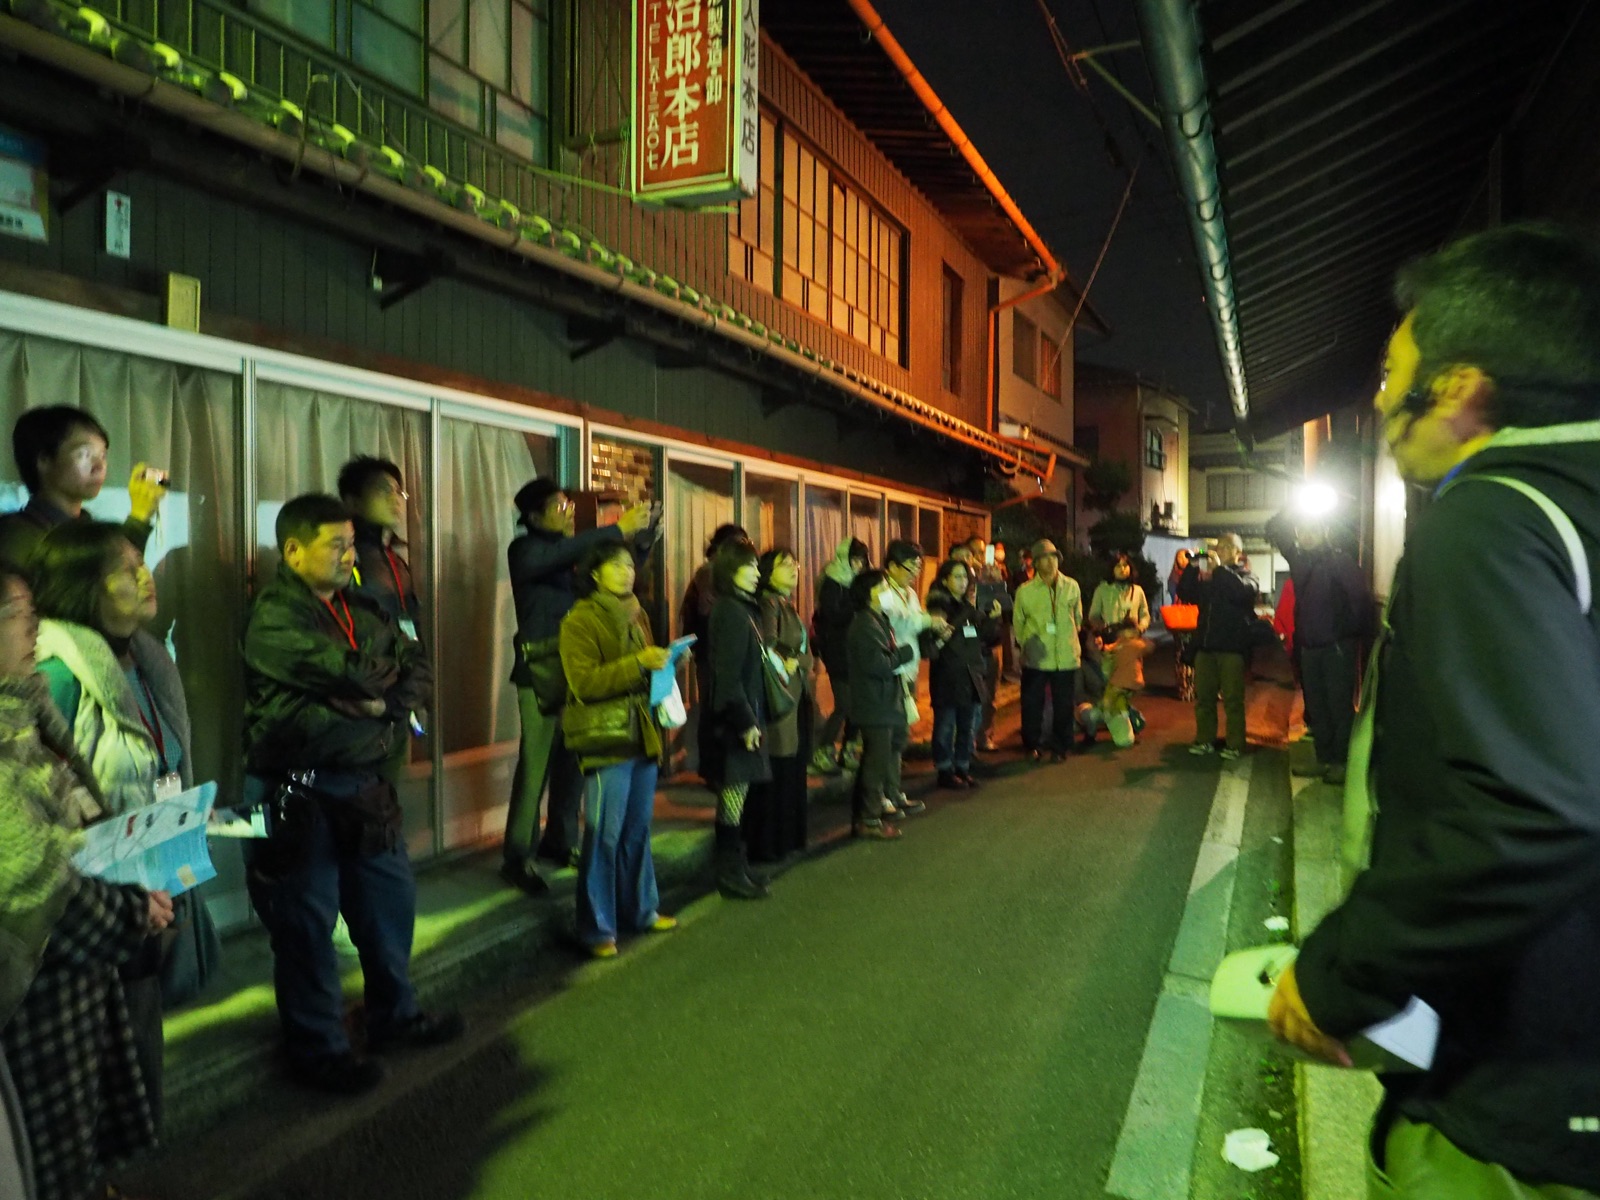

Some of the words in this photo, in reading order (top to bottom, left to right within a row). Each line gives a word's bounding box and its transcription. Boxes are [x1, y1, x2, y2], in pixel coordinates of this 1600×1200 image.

[661, 0, 702, 169] 治郎本店
[705, 0, 723, 105] 製造卸
[741, 0, 757, 156] 人形本店
